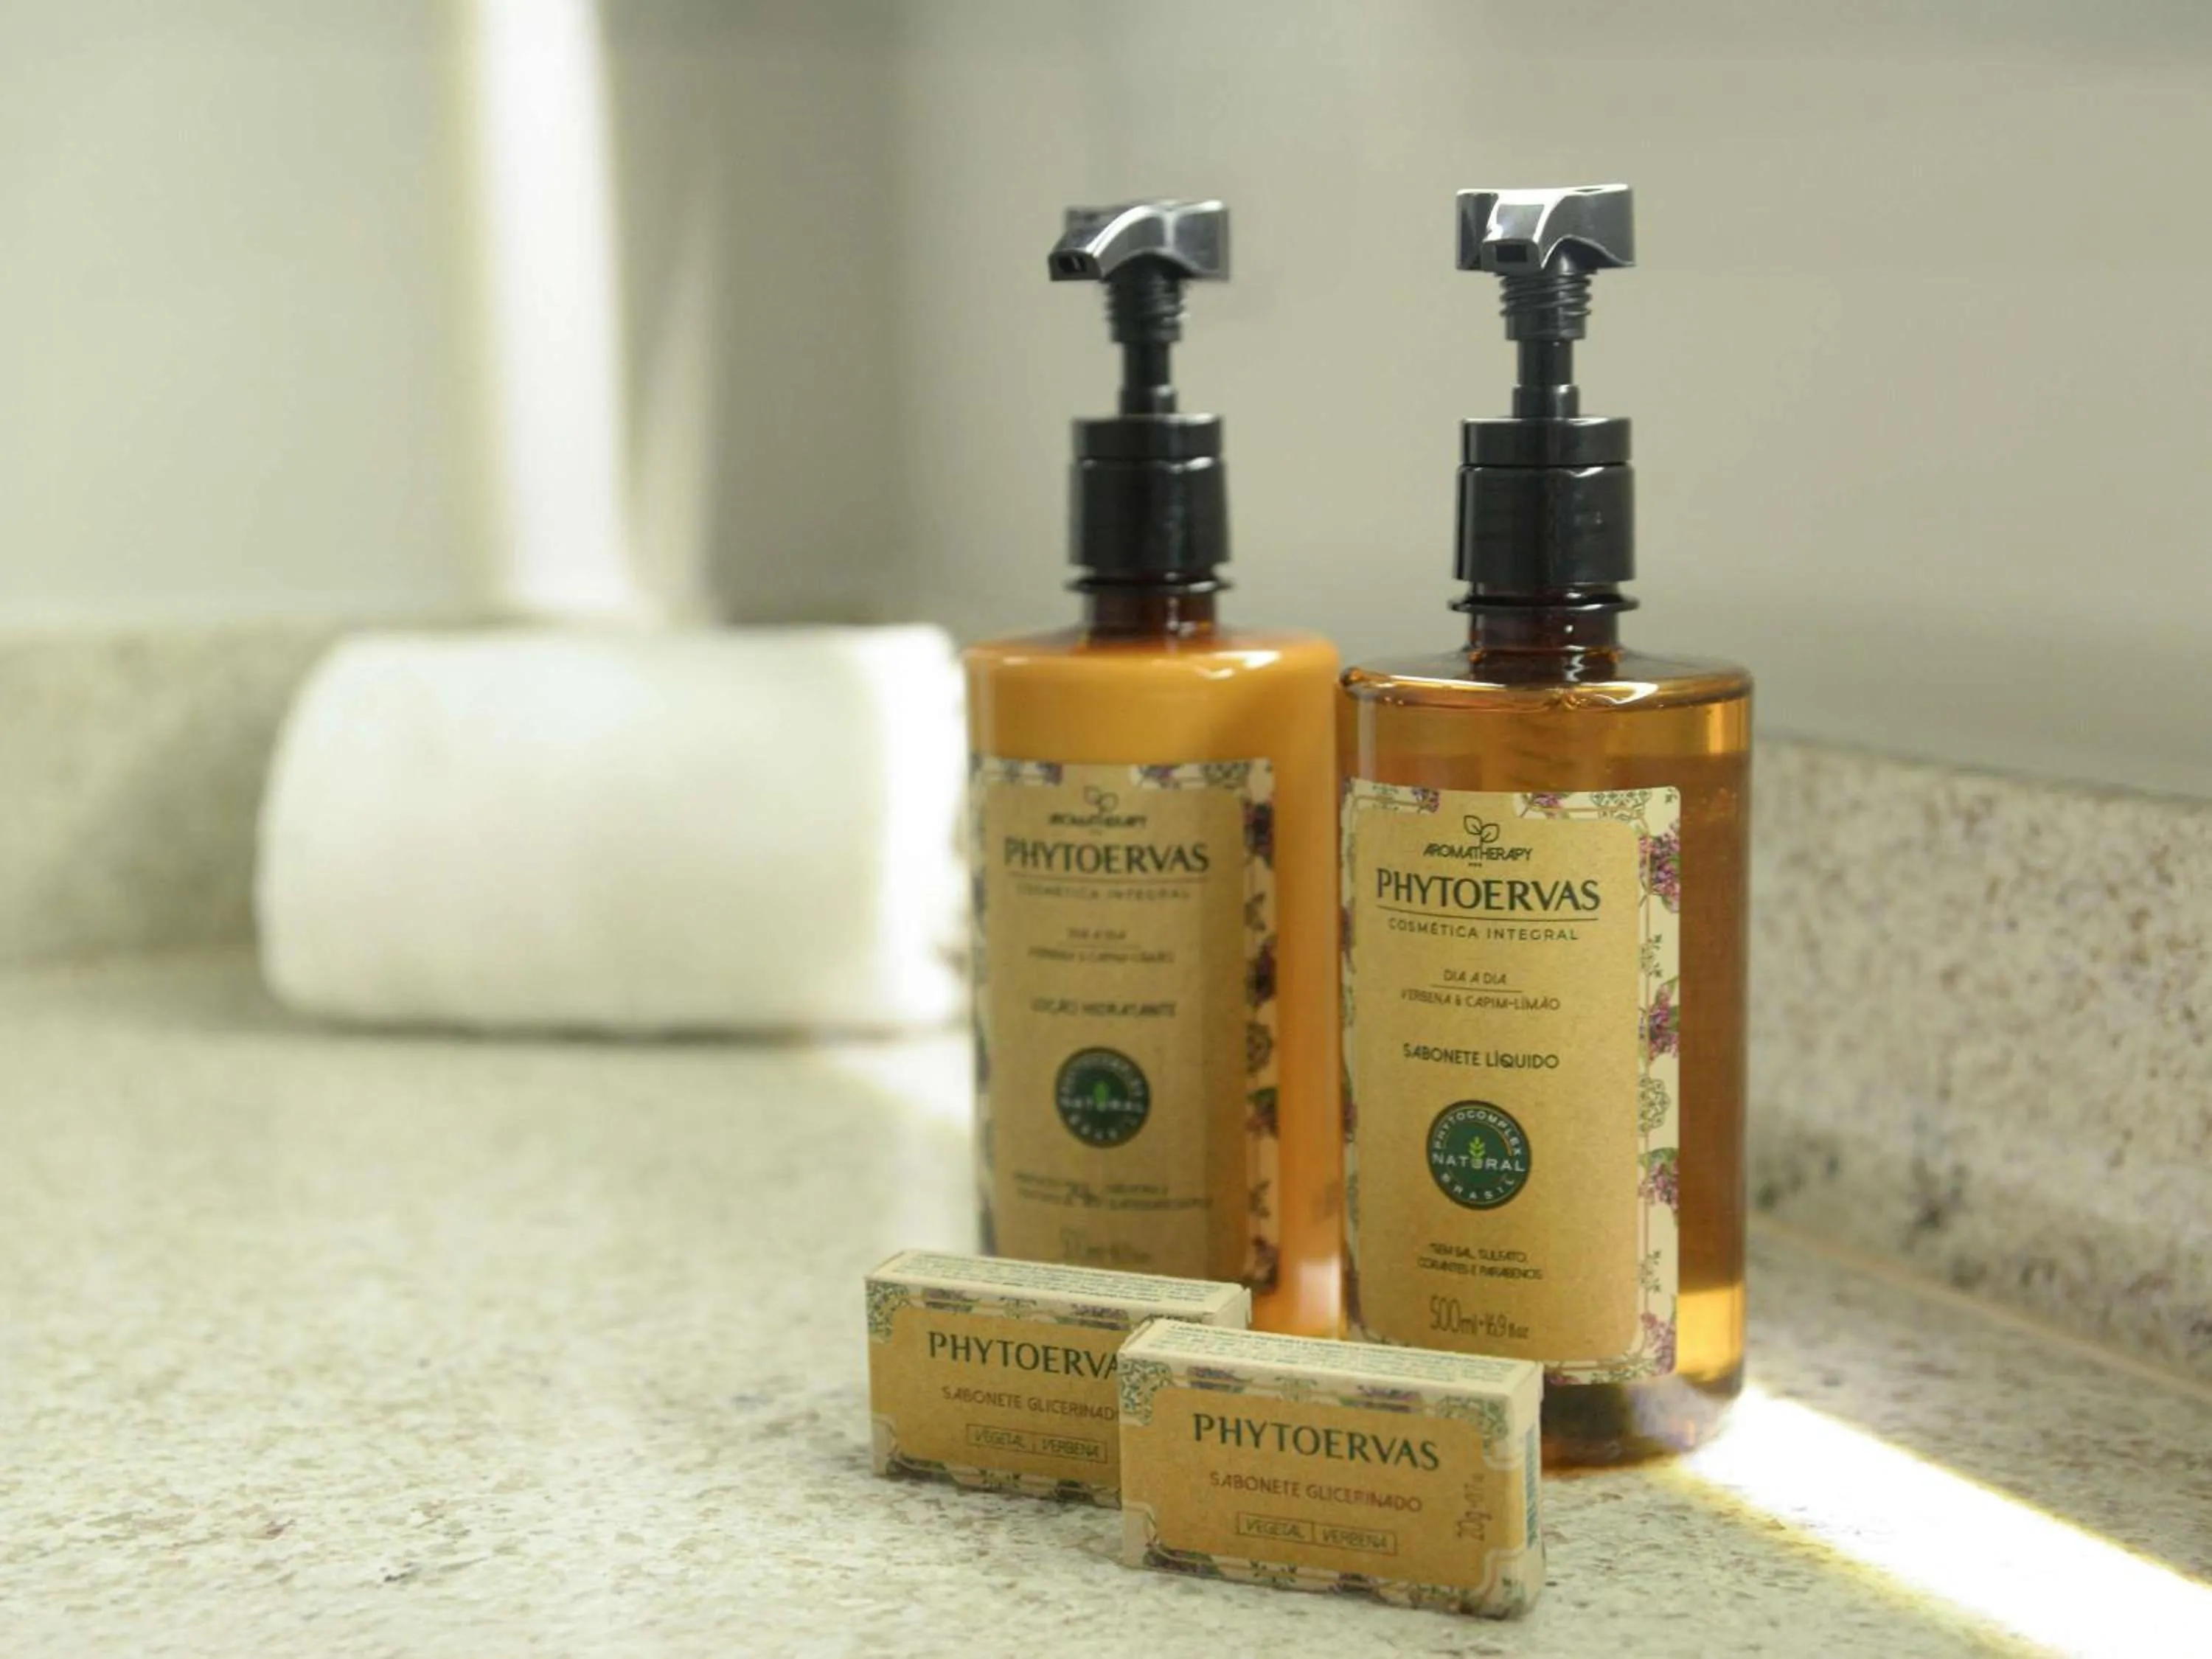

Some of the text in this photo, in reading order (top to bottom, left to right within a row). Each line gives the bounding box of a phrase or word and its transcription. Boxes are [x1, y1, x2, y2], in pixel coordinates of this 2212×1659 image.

[1004, 836, 1210, 874] PHYTOERVAS
[1422, 843, 1534, 862] AROMATHERAPY
[1376, 867, 1601, 912] PHYTOERVAS
[1388, 917, 1579, 942] COSMÉTICA INTEGRAL
[1443, 969, 1507, 985] DIA A DIA
[1401, 989, 1451, 1006] VERBENA
[1403, 1042, 1559, 1069] SABONETE LÍQUIDO
[1433, 1109, 1523, 1156] PHYTOCOMPLEX
[1431, 1152, 1526, 1172] NATURAL
[1440, 1173, 1515, 1200] BRASIL
[928, 1331, 1119, 1380] PHYTOERVA
[942, 1385, 1119, 1421] SABONETE GLICERINAD
[975, 1428, 1100, 1458] VEGETAL VERBENA
[1192, 1413, 1440, 1472] PHYTOERVAS
[1208, 1470, 1423, 1513] SABONETE GLICERINADO
[1246, 1517, 1304, 1540] VEGETAL
